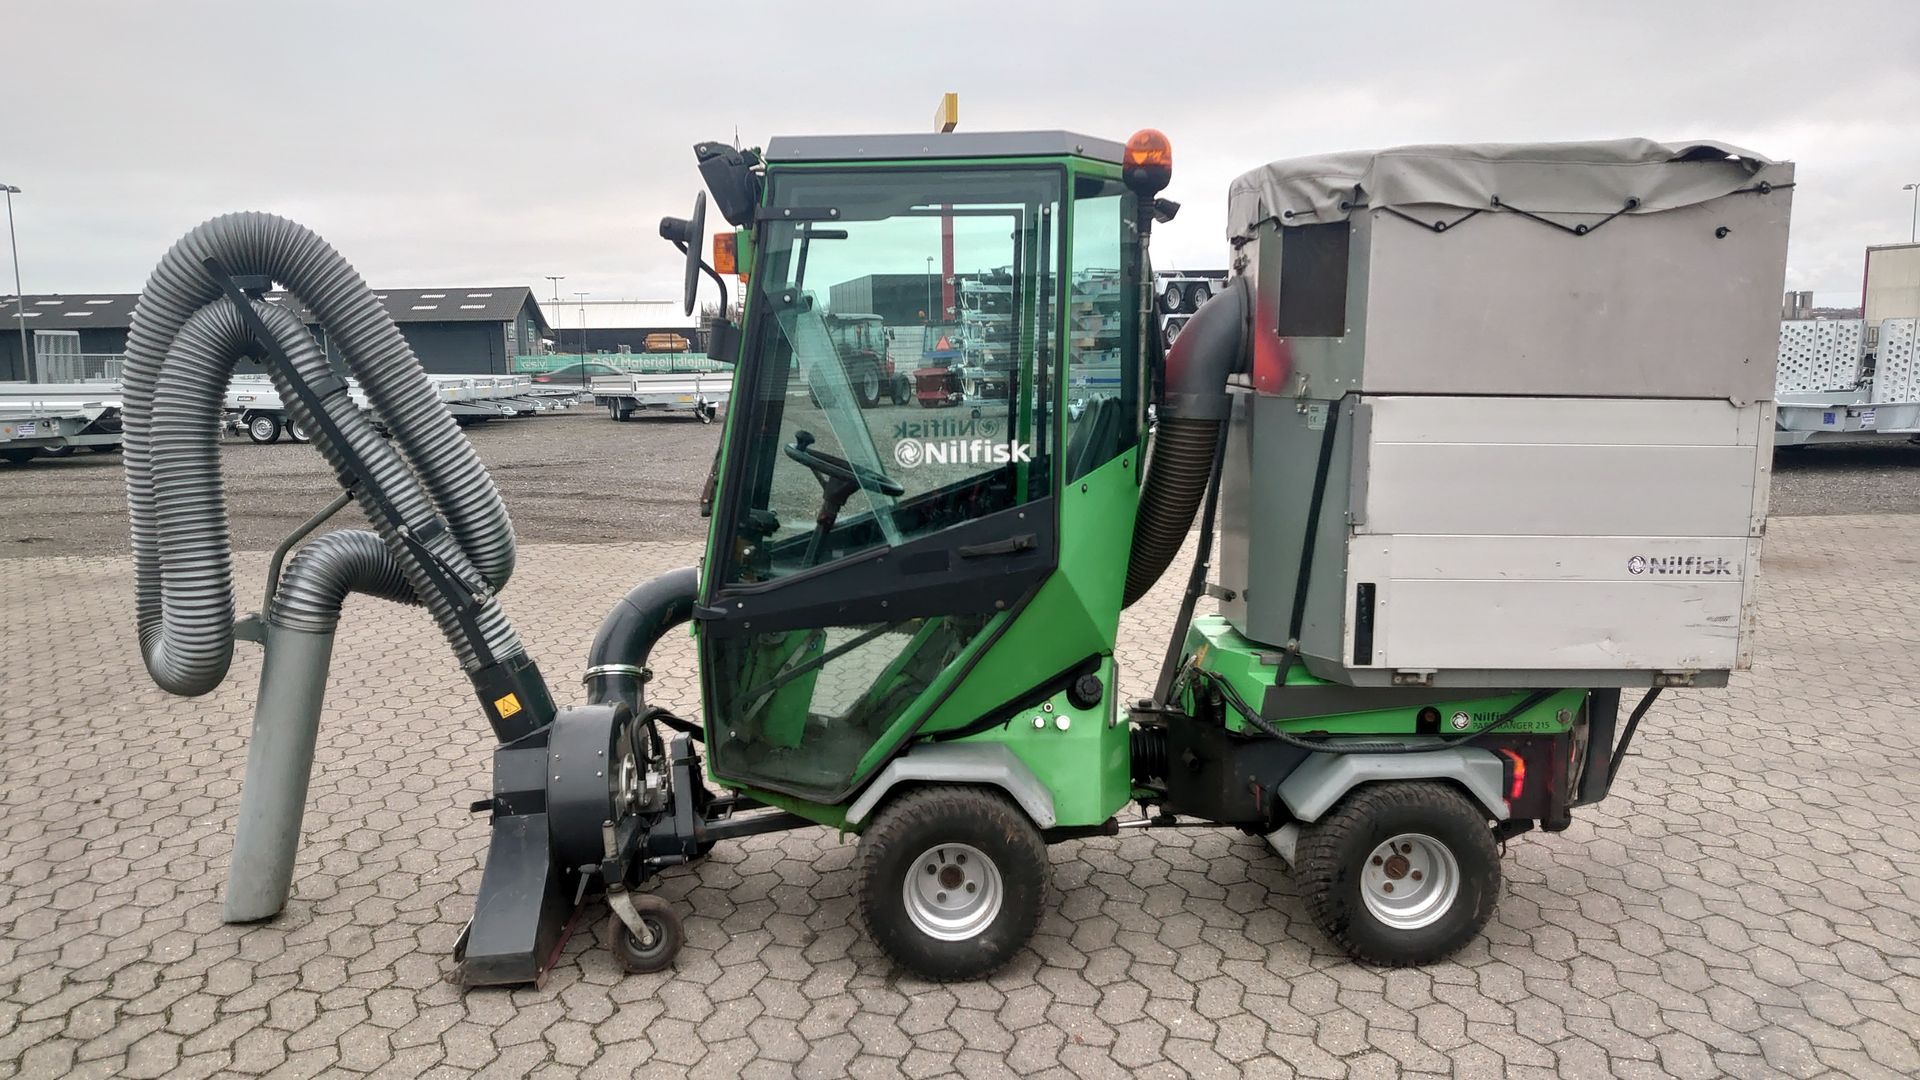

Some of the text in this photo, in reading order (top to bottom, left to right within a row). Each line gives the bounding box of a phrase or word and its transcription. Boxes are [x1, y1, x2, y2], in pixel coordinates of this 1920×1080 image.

[925, 439, 1032, 464] Nilfisk
[1649, 556, 1731, 575] Nilfisk
[1473, 711, 1510, 721] Nilfi
